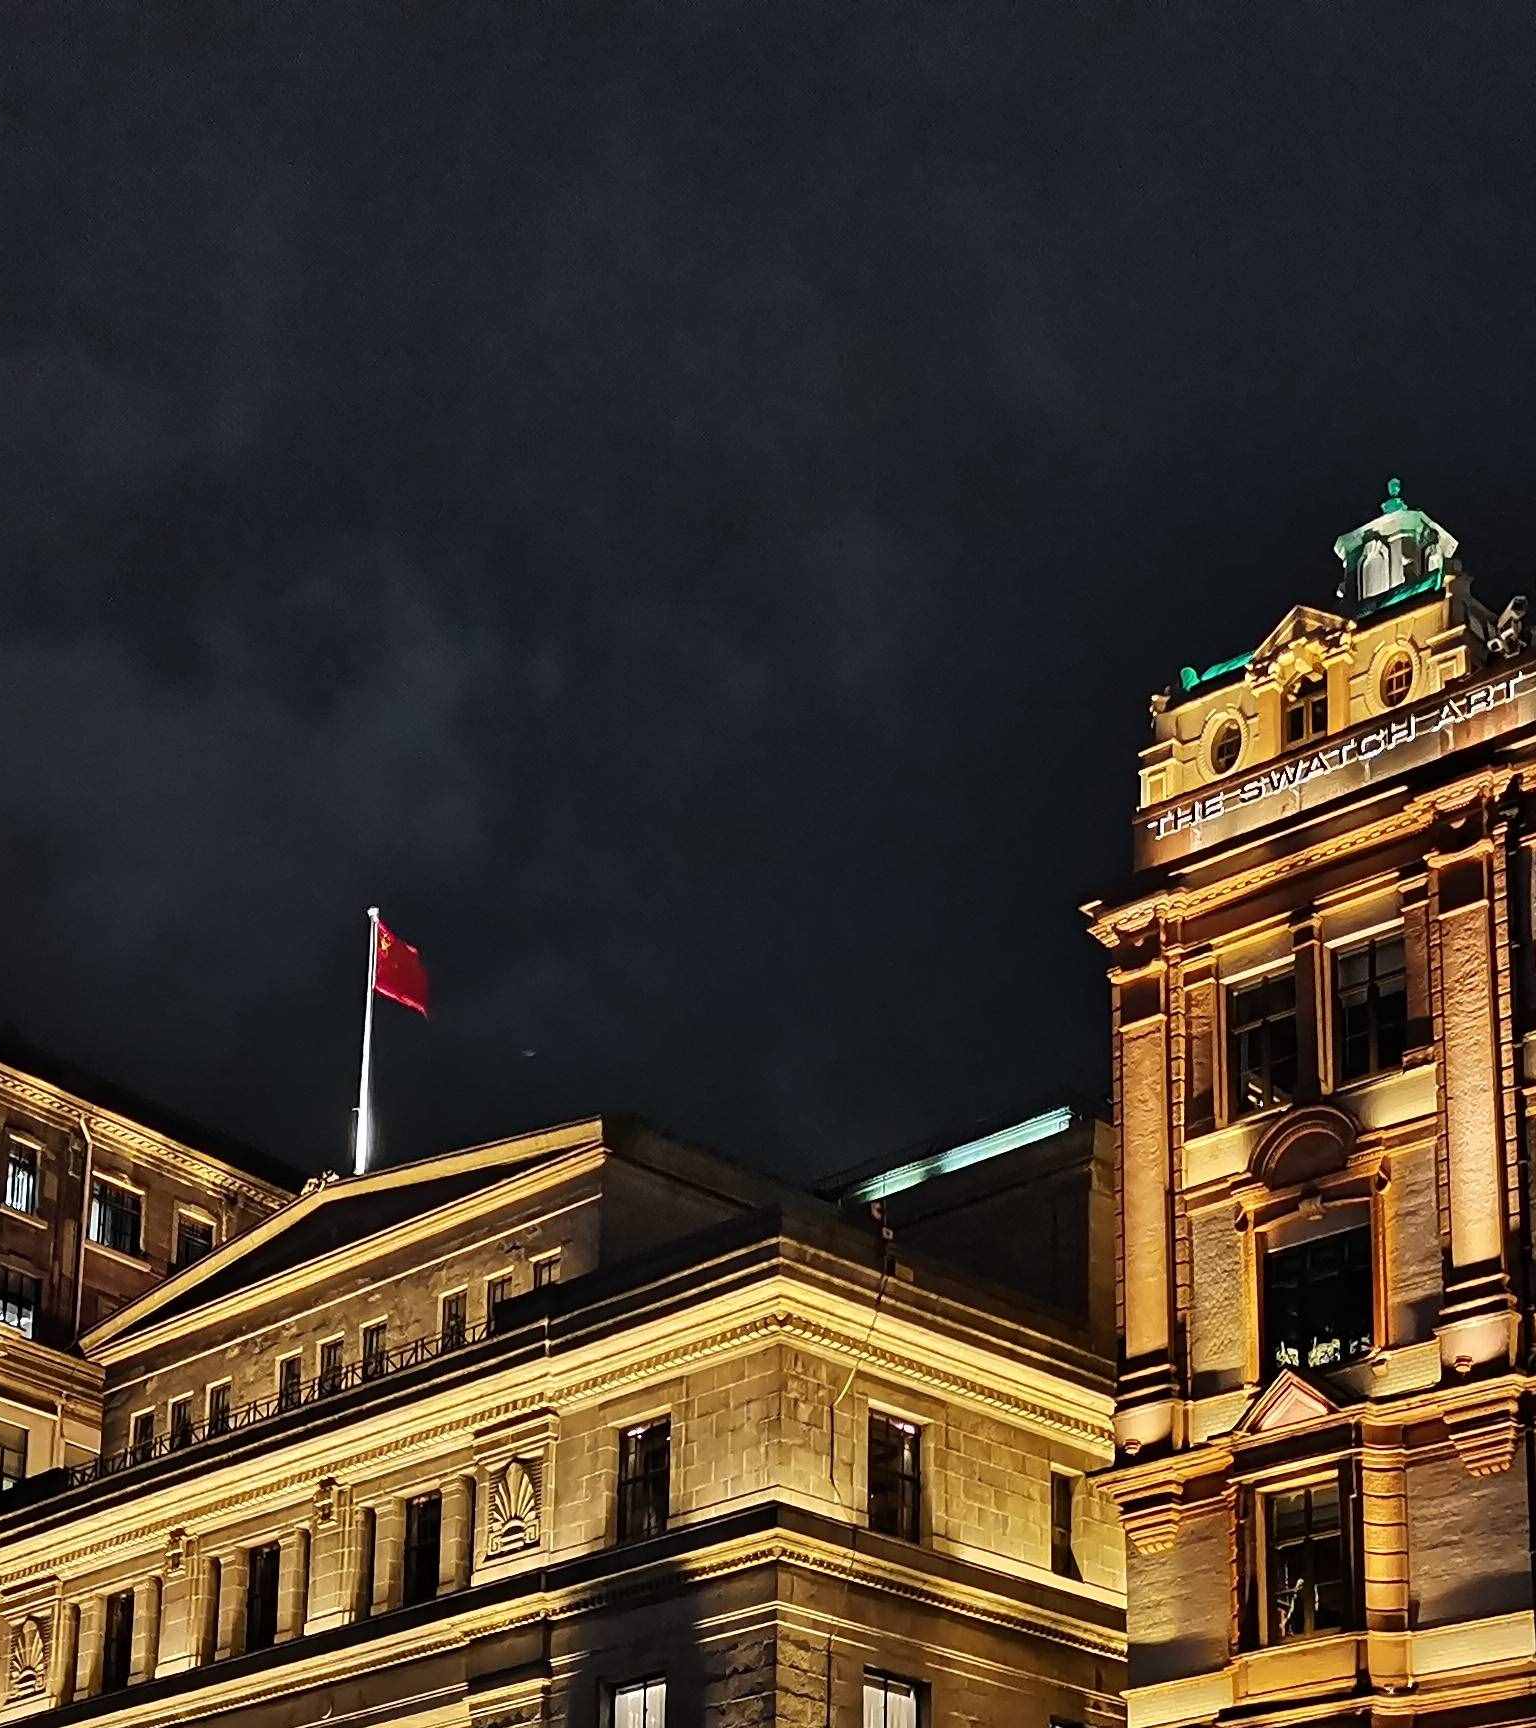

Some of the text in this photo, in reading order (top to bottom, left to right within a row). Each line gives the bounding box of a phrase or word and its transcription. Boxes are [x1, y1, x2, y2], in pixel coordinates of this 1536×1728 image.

[1146, 792, 1224, 840] THE
[1239, 714, 1416, 802] SWATCH
[1430, 671, 1524, 733] ART
